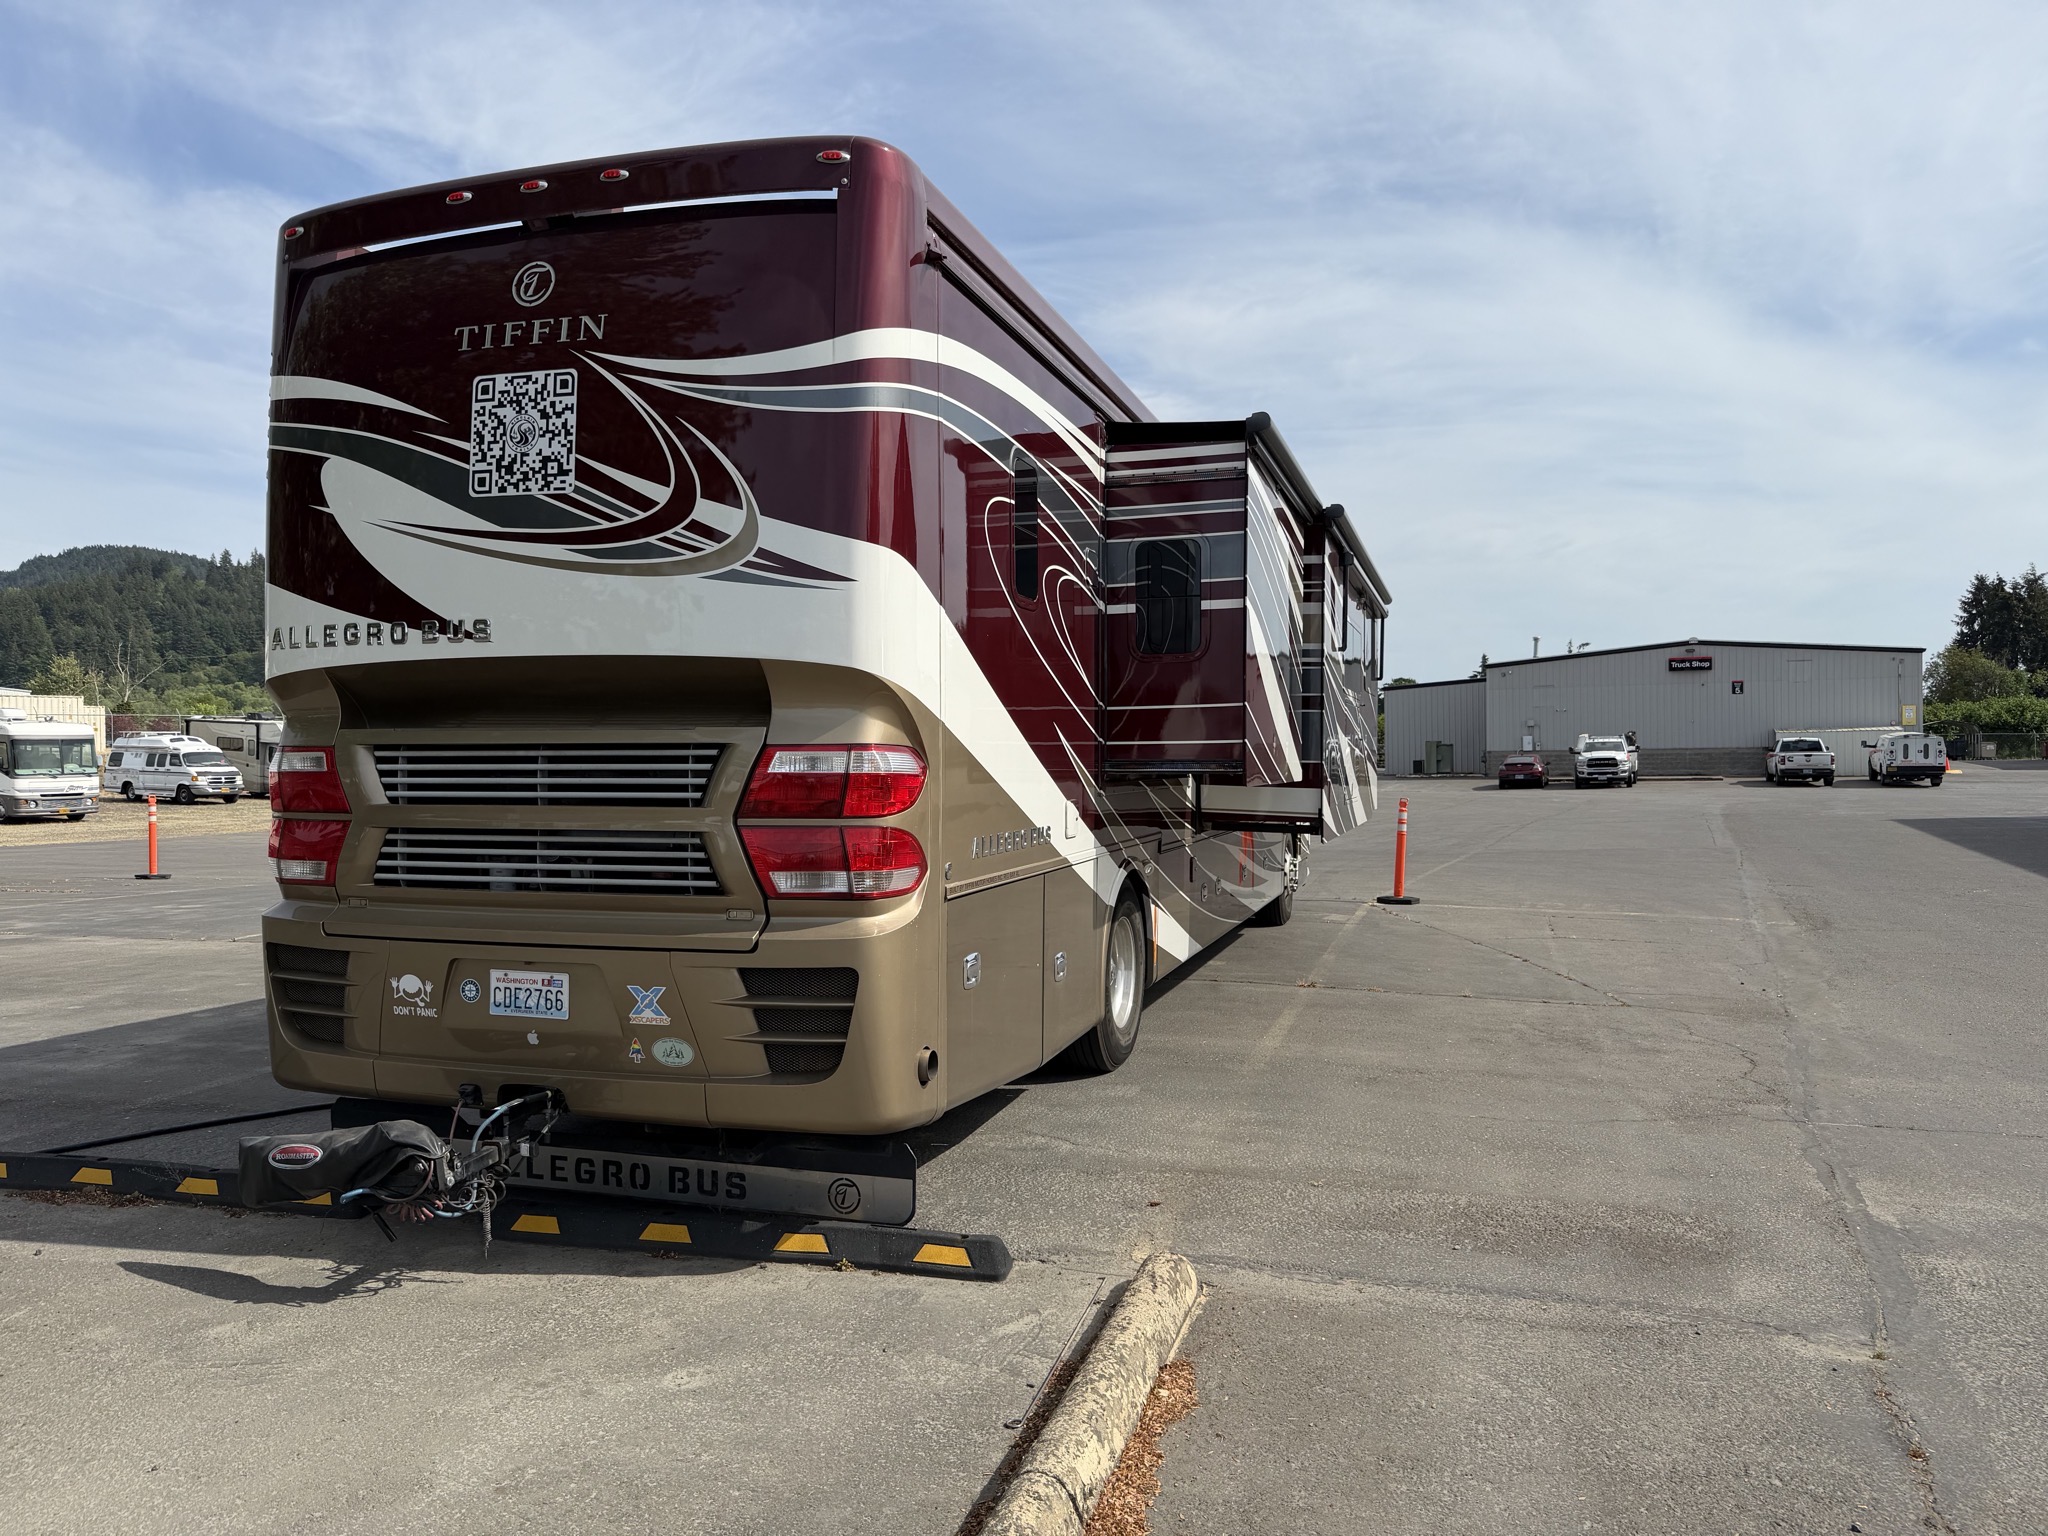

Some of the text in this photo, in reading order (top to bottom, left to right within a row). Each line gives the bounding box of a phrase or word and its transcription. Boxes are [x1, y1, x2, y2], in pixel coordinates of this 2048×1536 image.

[454, 313, 608, 351] TIFFIN
[271, 618, 492, 650] ALLEGRO BUS
[1692, 660, 1710, 668] Shop
[971, 830, 1027, 860] ALLEGRO
[495, 976, 539, 986] WASHINGTON
[493, 986, 563, 1012] CDE2766
[393, 1005, 438, 1018] DON'T PANIC
[631, 1016, 670, 1025] XSCAPERS
[275, 1152, 315, 1160] ROADMASTER
[668, 1165, 747, 1200] BUS
